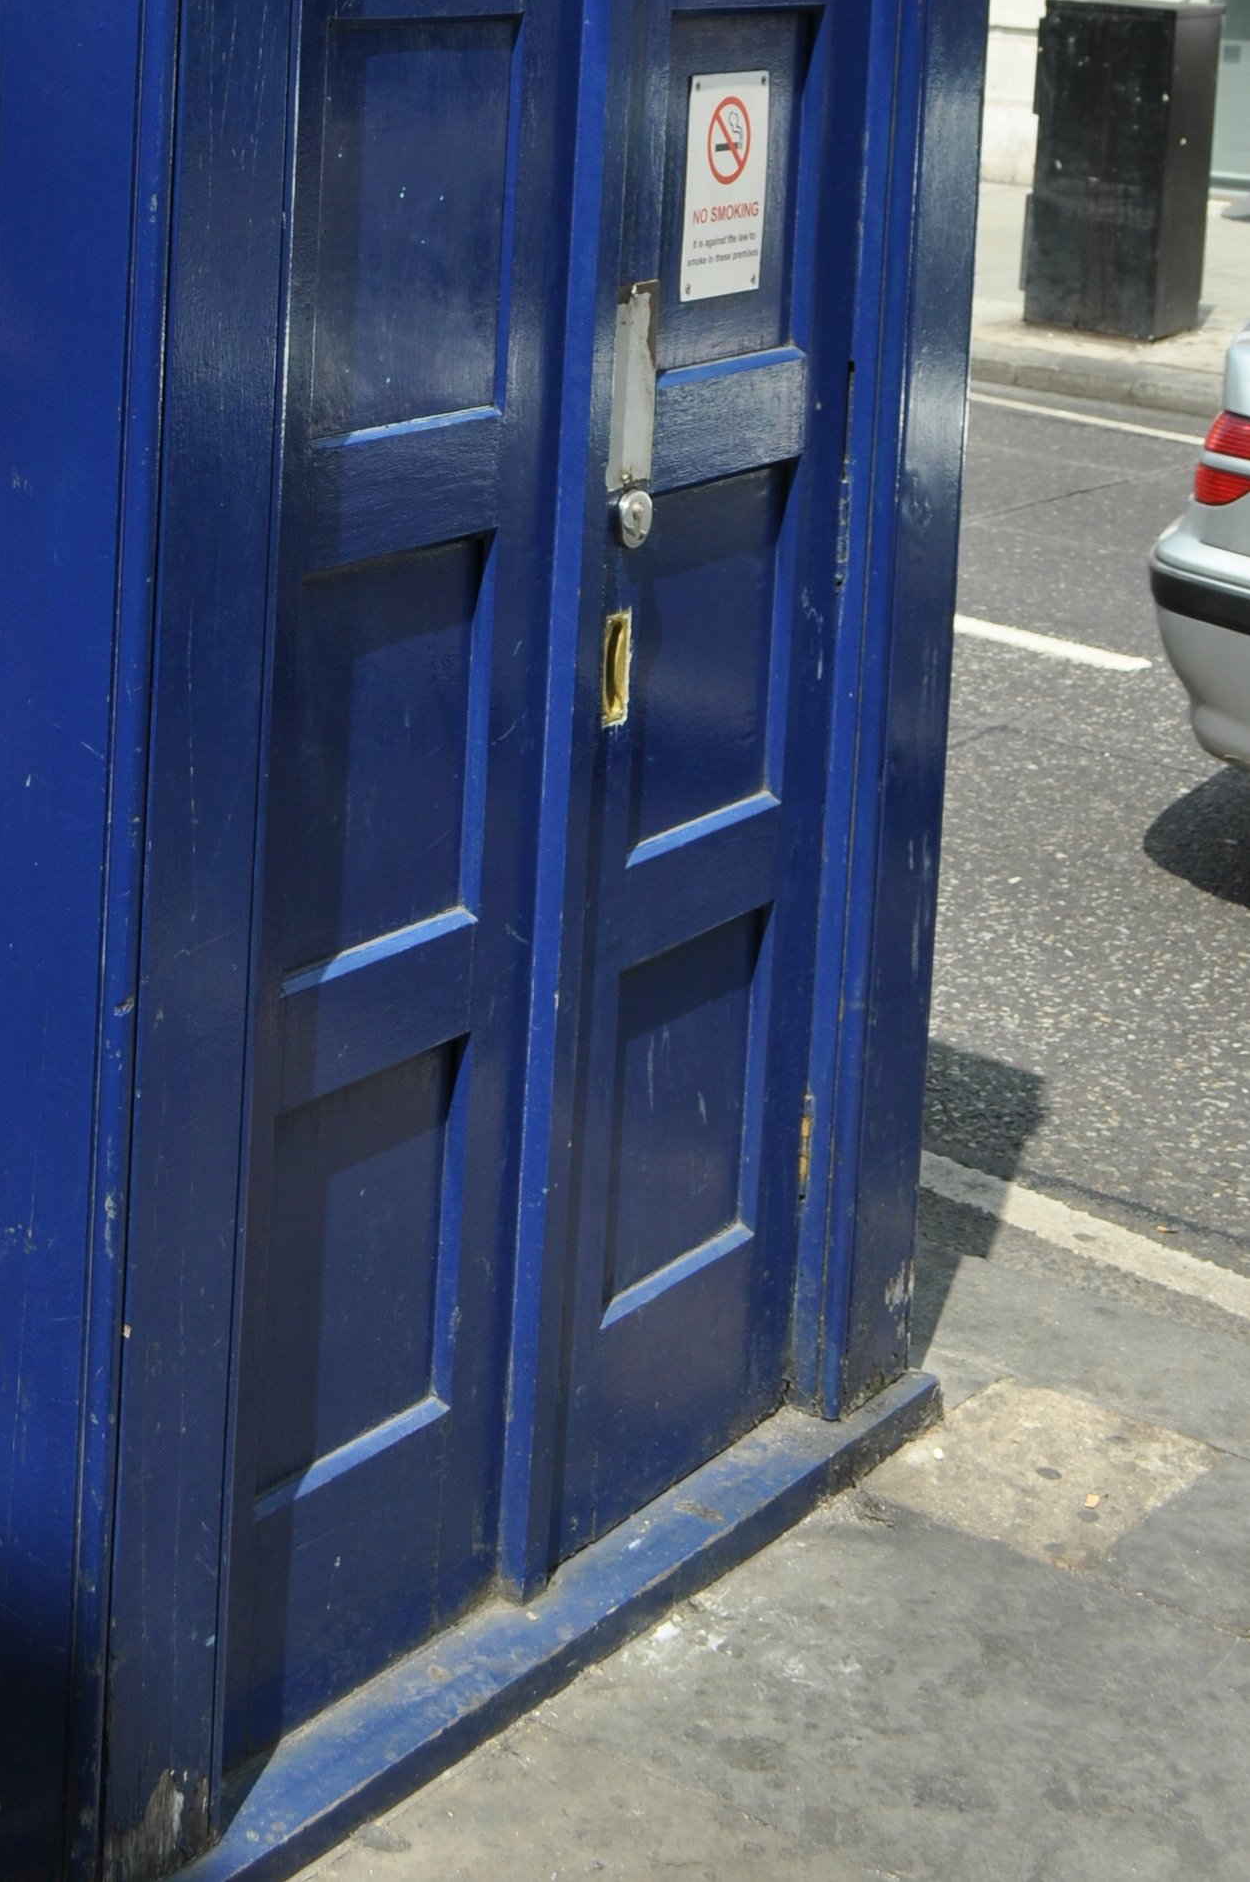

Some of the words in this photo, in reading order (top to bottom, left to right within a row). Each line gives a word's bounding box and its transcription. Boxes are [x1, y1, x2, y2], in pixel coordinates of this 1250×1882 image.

[693, 208, 708, 225] NO
[710, 201, 759, 222] SMOKING
[705, 236, 726, 249] against
[688, 258, 707, 267] smoke
